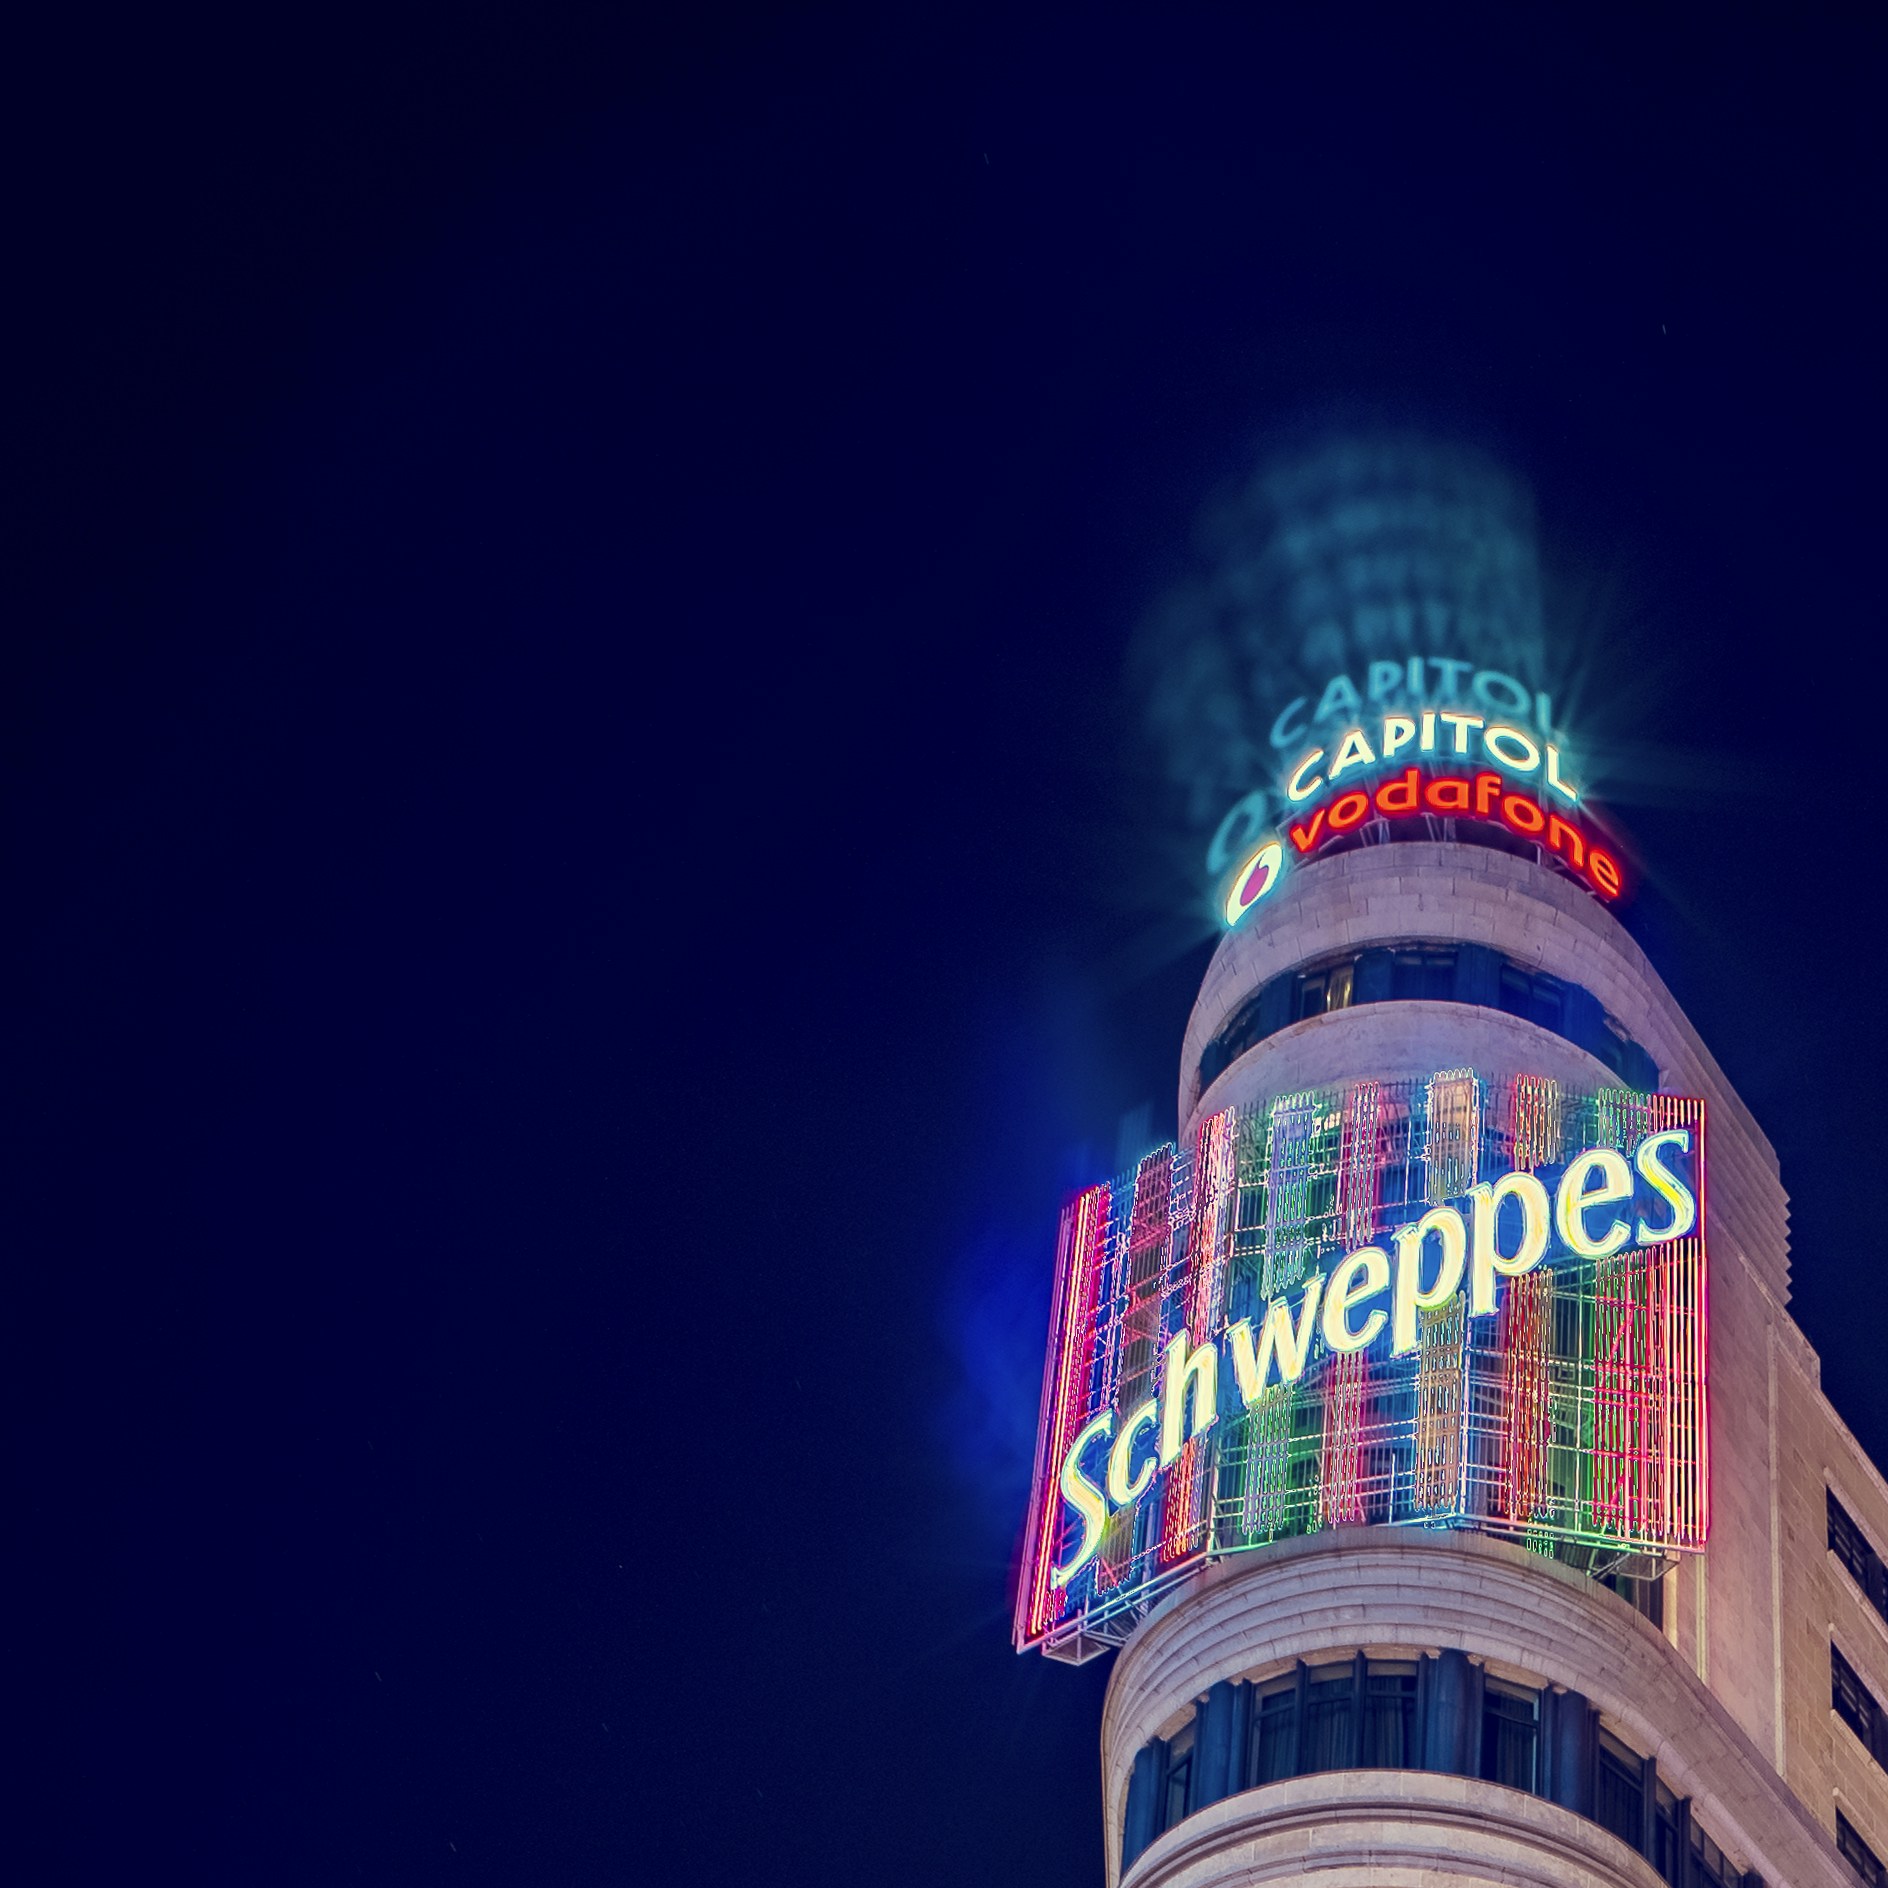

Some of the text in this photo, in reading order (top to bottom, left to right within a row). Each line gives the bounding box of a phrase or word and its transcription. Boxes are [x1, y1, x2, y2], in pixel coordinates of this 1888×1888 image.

[1286, 711, 1580, 803] CAPITOL
[1289, 767, 1623, 899] vodafone
[1050, 1127, 1699, 1588] Schweppes
